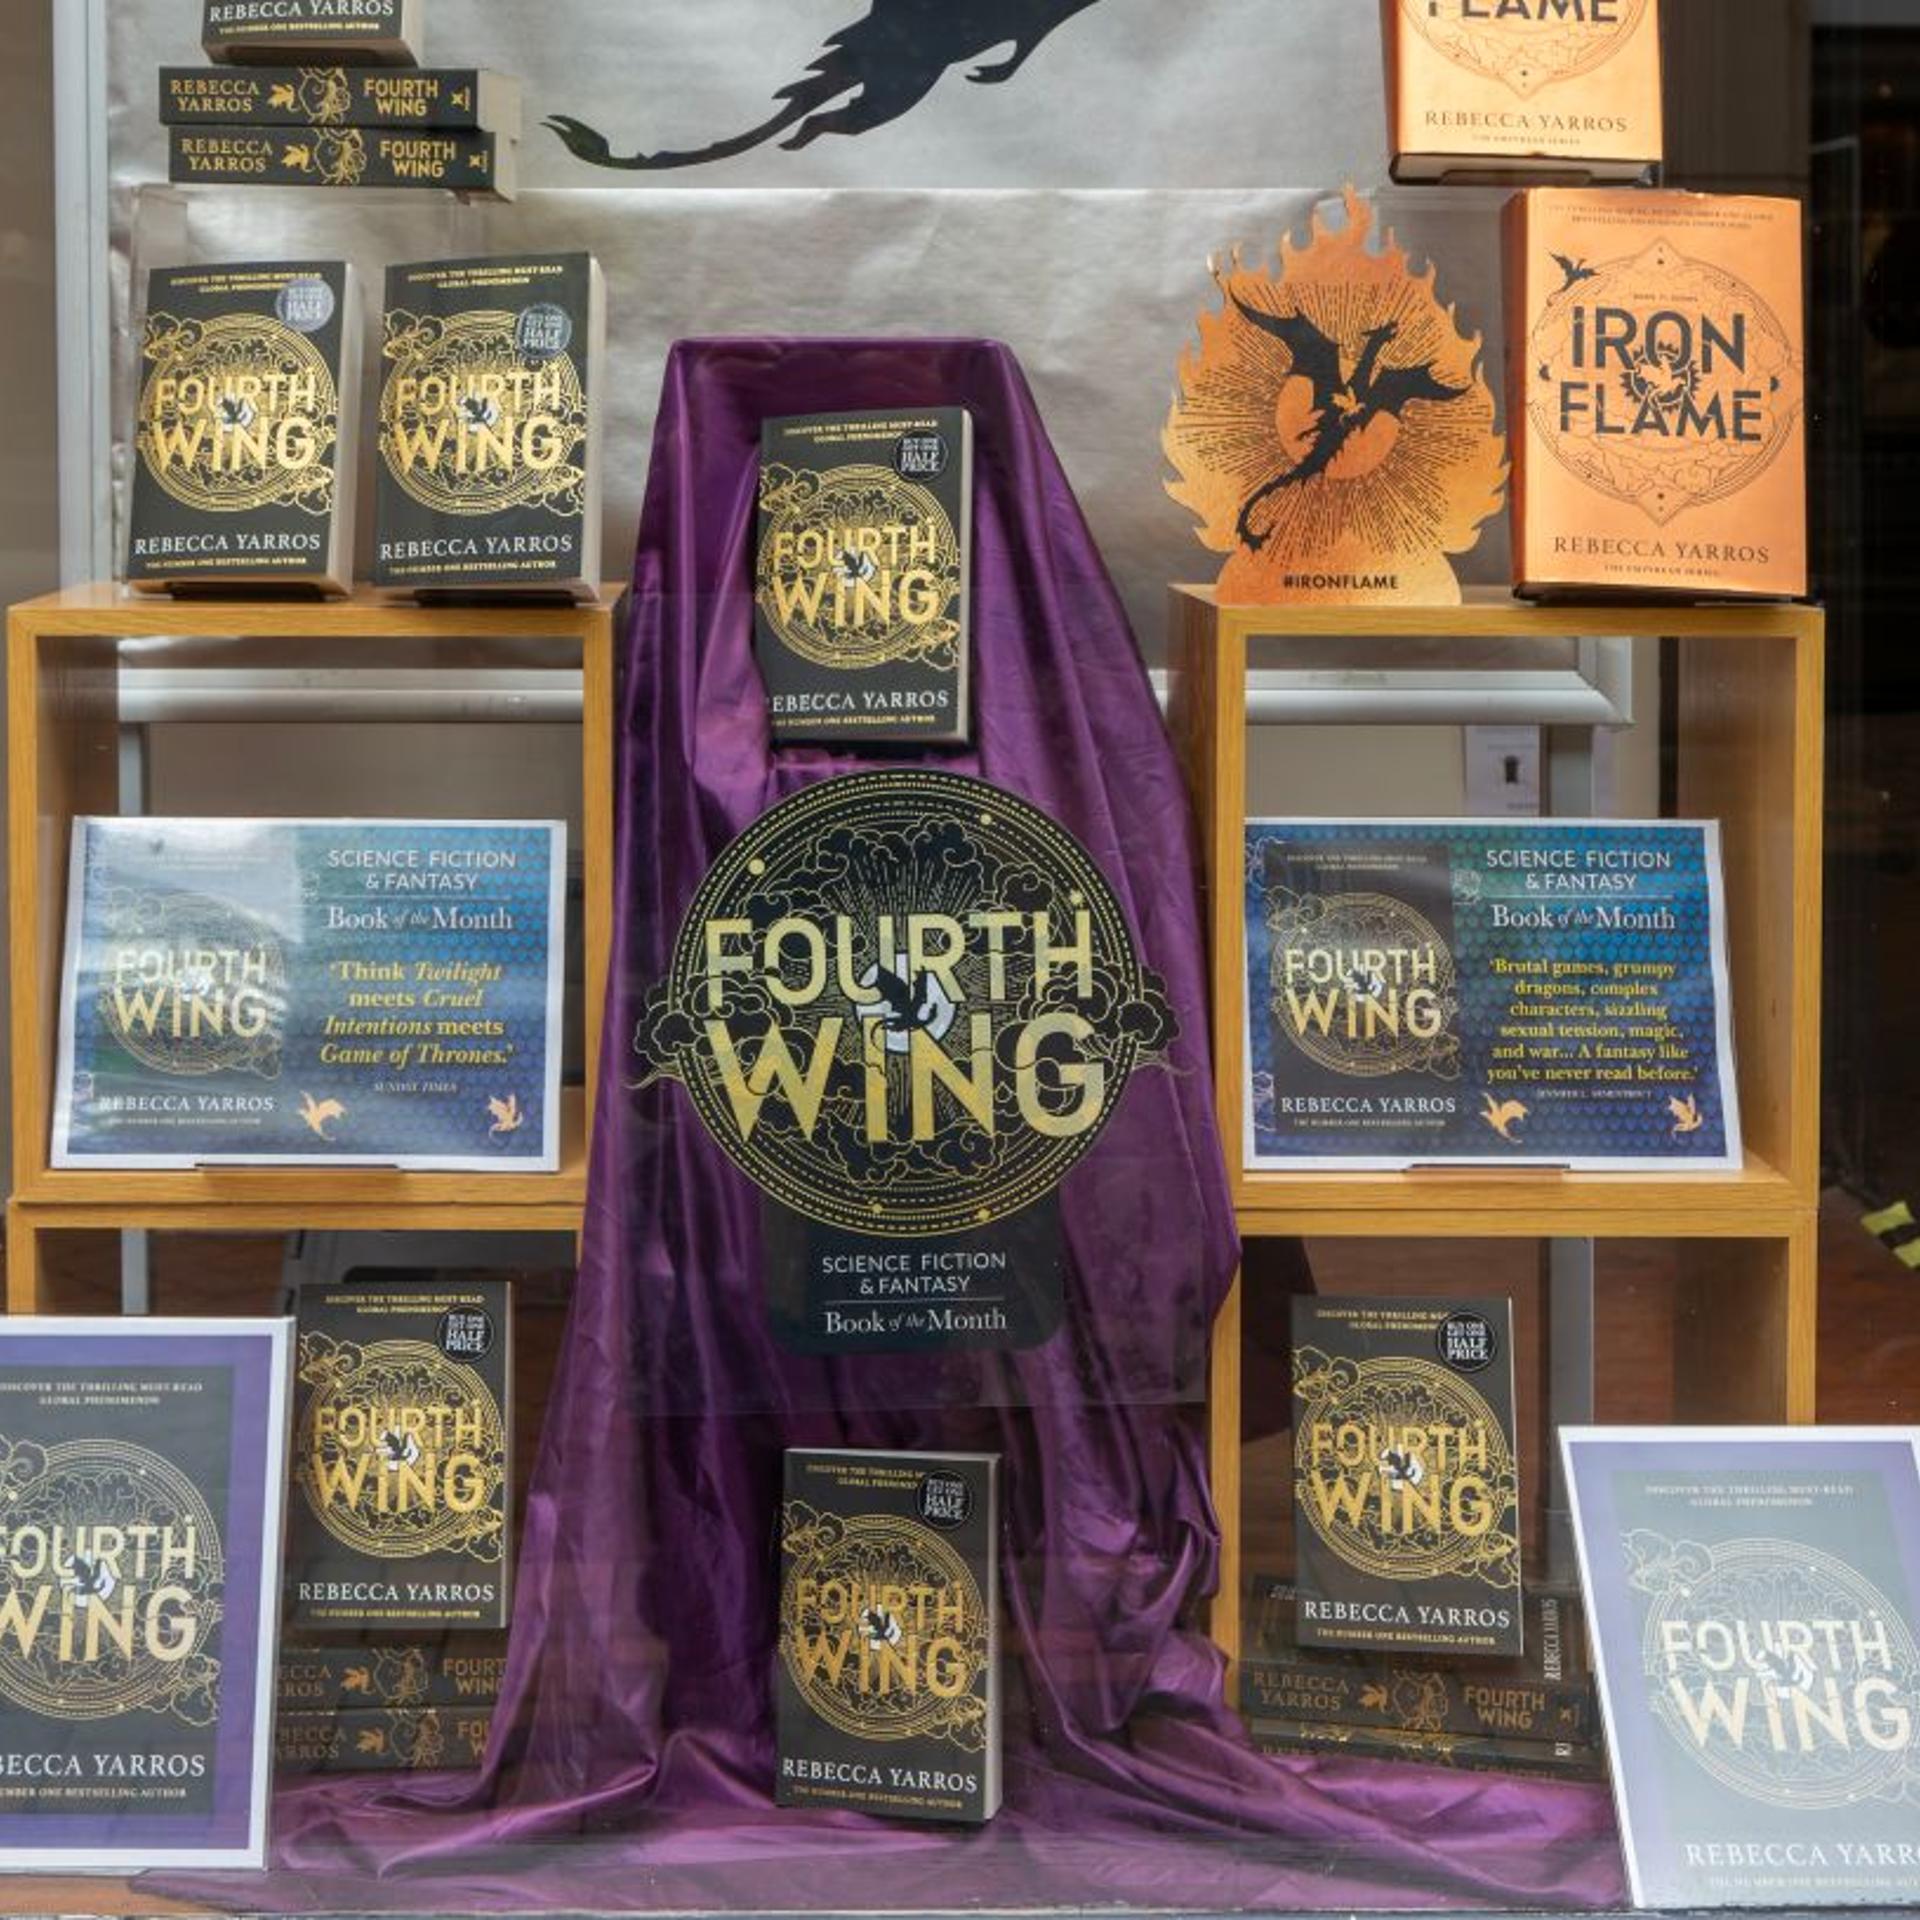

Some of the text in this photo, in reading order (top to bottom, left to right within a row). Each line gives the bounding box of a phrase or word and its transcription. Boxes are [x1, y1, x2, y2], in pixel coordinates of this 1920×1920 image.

[210, 0, 394, 22] REBECCA YARROS
[170, 79, 260, 95] REBECCA
[364, 79, 438, 98] FOURTH
[177, 97, 252, 112] YARROS
[377, 99, 427, 117] WING
[1425, 109, 1628, 133] REBECCA YARROS
[181, 138, 273, 156] REBECCA
[380, 140, 456, 160] FOURTH
[188, 157, 267, 173] YARROS
[392, 158, 445, 178] WING
[1572, 306, 1745, 374] IRON
[155, 370, 316, 418] FOURTH
[395, 371, 561, 420] FOURTH
[1560, 381, 1762, 442] FLAME
[152, 416, 315, 472] WING
[394, 415, 563, 474] WING
[135, 533, 321, 555] REBECCA YARROS
[380, 535, 573, 560] REBECCA YARROS
[773, 523, 937, 577] FOURTH
[1554, 536, 1770, 564] REBECCA YARROS
[1282, 574, 1399, 590] #IRONFLAME
[772, 568, 941, 628] WING
[773, 690, 950, 713] EBECCA YARROS
[327, 850, 516, 868] SCIENCE FICTION
[1486, 850, 1671, 868] SCIENCE FICTION
[366, 873, 479, 891] & FANTASY
[1525, 874, 1638, 890] & FANTASY
[328, 906, 388, 929] Book
[432, 906, 513, 930] Month
[1491, 904, 1554, 927] Book
[1595, 906, 1675, 929] Month
[116, 949, 266, 985] FOURTH
[704, 909, 1093, 1011] FOURTH
[1284, 949, 1437, 985] FOURTH
[1613, 962, 1675, 979] grumpy
[415, 960, 502, 987] Twilight
[350, 989, 484, 1008] meets Cruel
[113, 985, 267, 1038] WING
[1285, 987, 1442, 1039] WING
[1604, 1003, 1667, 1020] sizzling
[324, 1015, 504, 1035] Intentions meets
[1500, 1023, 1554, 1037] sexual
[320, 1043, 384, 1064] Game
[389, 1043, 412, 1070] of
[1492, 1044, 1524, 1058] and
[1578, 1044, 1591, 1058] A
[1595, 1044, 1655, 1063] fantasy
[1660, 1045, 1689, 1059] like
[703, 1011, 1105, 1142] WING
[1545, 1069, 1591, 1080] never
[1596, 1066, 1632, 1080] read
[100, 1096, 274, 1112] REBECCA YARROS
[1281, 1097, 1456, 1113] REBECCA YARROS
[822, 1252, 1006, 1274] SCIENCE FICTION
[860, 1276, 971, 1295] & FANTASY
[824, 1310, 886, 1334] Book
[927, 1307, 1007, 1331] Month
[1447, 1338, 1488, 1348] HALF
[1447, 1349, 1488, 1360] PRICE
[314, 1406, 482, 1448] FOURTH
[1311, 1421, 1488, 1473] FOURTH
[313, 1452, 486, 1513] WING
[1311, 1471, 1494, 1536] WING
[0, 1525, 196, 1580] OURTH
[300, 1582, 495, 1602] REBECCA YARROS
[796, 1579, 964, 1634] FOURTH
[1304, 1600, 1511, 1629] REBECCA YARROS
[1661, 1620, 1893, 1672] FOURTH
[443, 1657, 507, 1676] FOURT
[796, 1628, 968, 1697] WING
[1464, 1686, 1545, 1711] FOURTH
[1477, 1706, 1532, 1729] WING
[1667, 1676, 1912, 1752] WING
[0, 1754, 206, 1777] ECCA YARROS
[782, 1758, 978, 1793] REBECCA YARROS
[1685, 1843, 1920, 1866] REBECCA YARR
